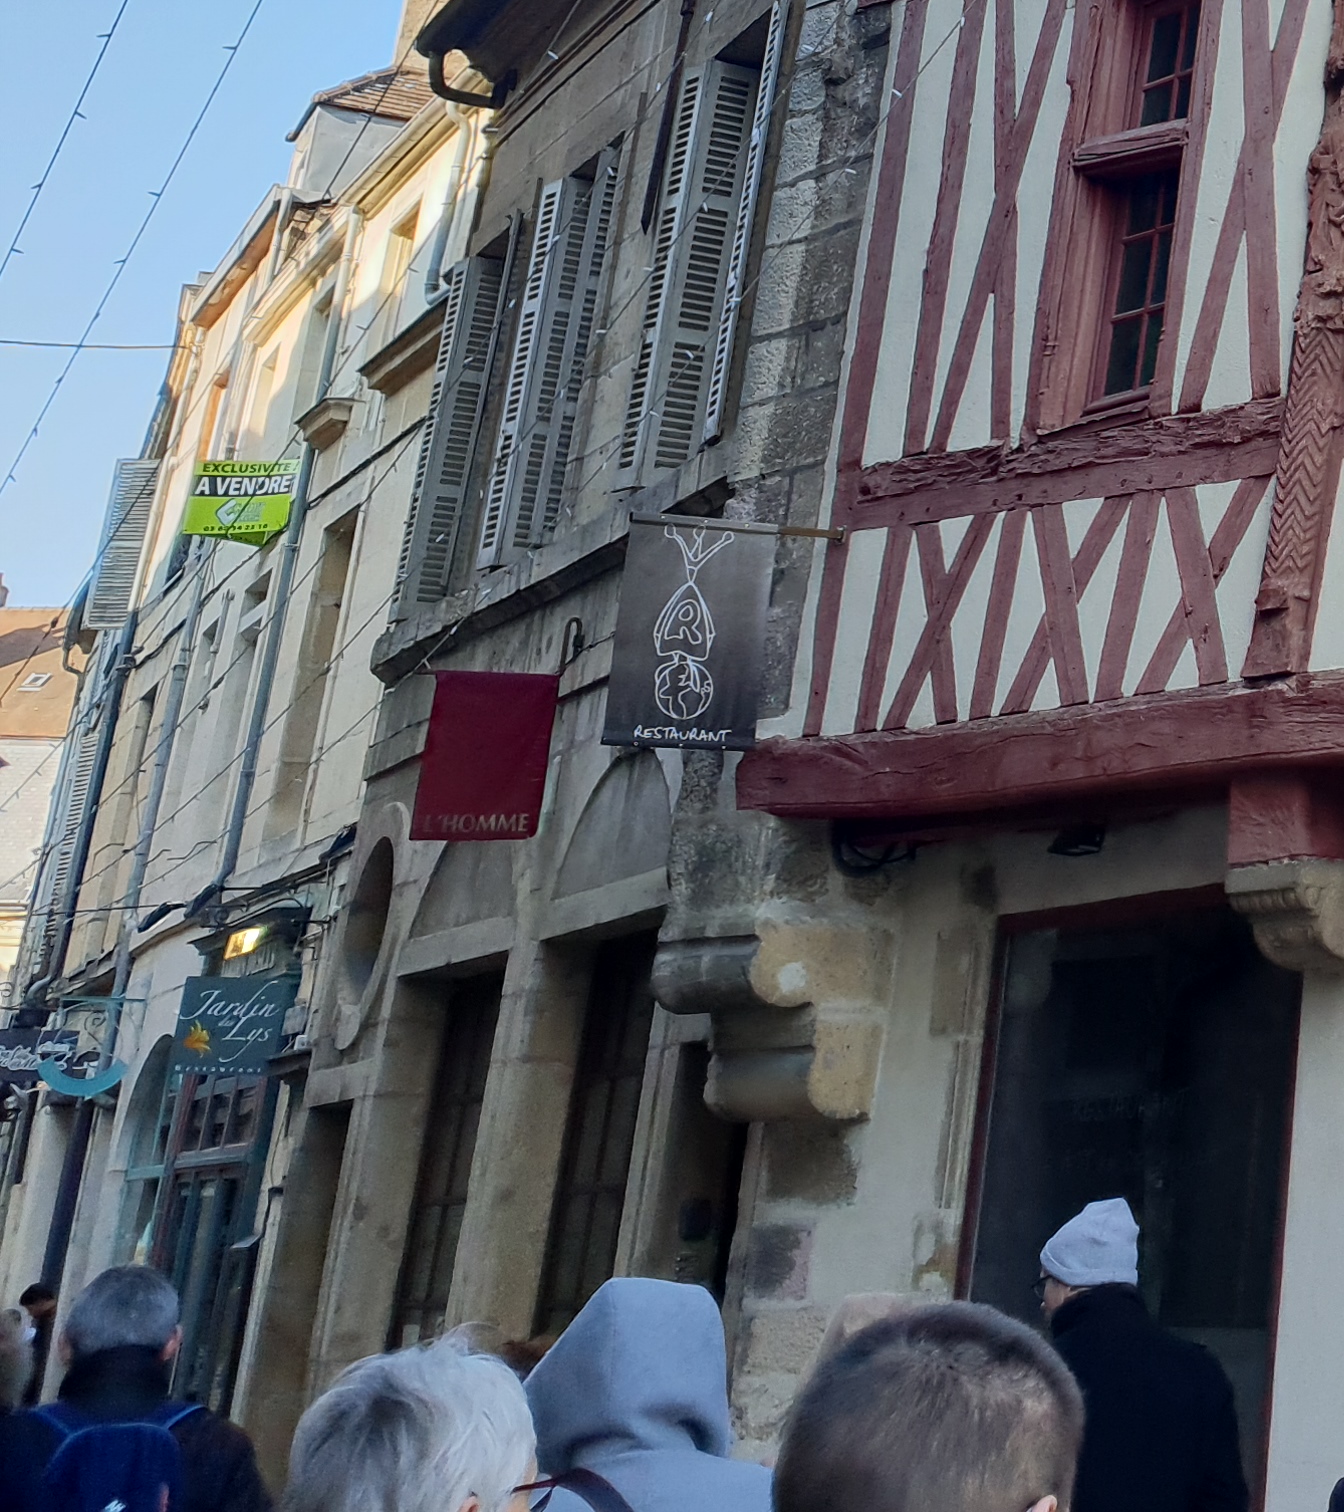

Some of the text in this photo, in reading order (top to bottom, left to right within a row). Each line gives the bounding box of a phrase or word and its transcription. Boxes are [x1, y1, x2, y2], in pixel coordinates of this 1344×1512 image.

[194, 475, 292, 496] A VENDRE
[633, 723, 733, 743] RESTAURANT
[422, 813, 529, 833] L'HOMME
[179, 980, 279, 1020] Jardin
[219, 1016, 273, 1063] Lys
